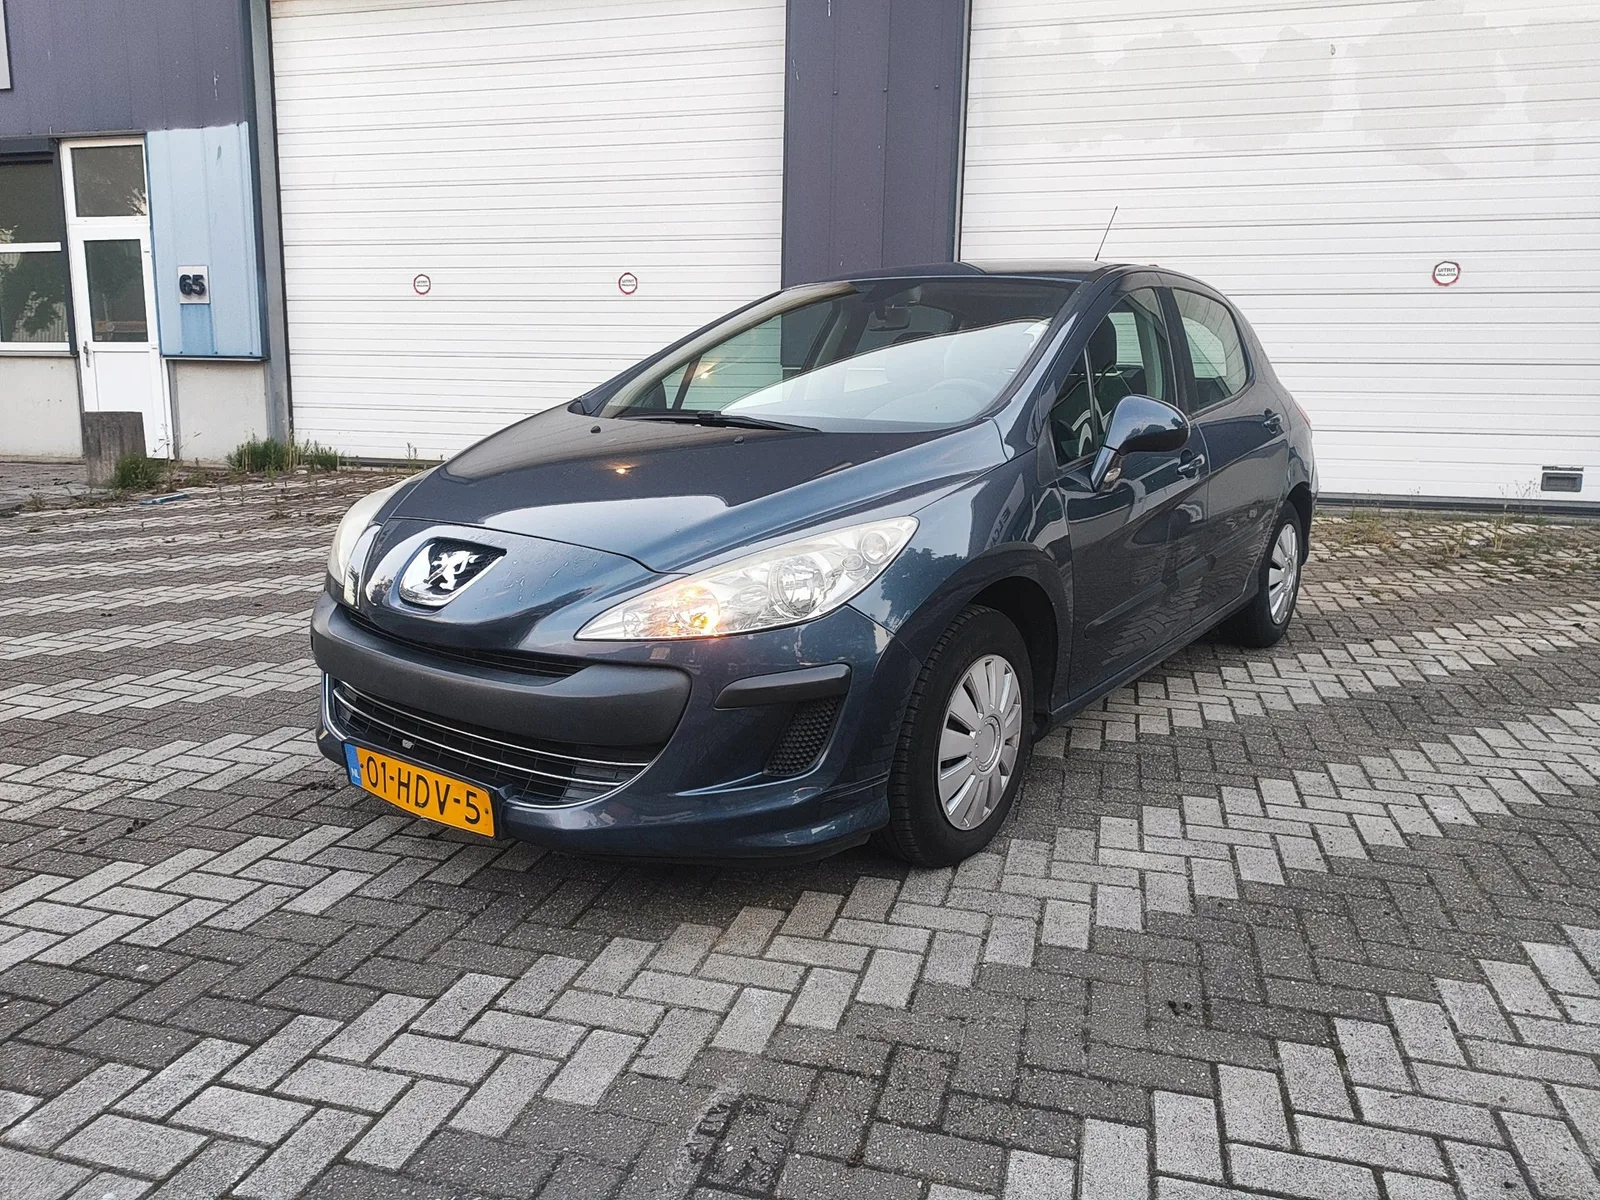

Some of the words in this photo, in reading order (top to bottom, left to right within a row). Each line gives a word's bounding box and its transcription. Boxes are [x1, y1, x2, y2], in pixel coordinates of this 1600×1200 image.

[179, 274, 206, 296] 65
[350, 767, 361, 779] NL
[366, 756, 482, 825] 01-HDV-5
